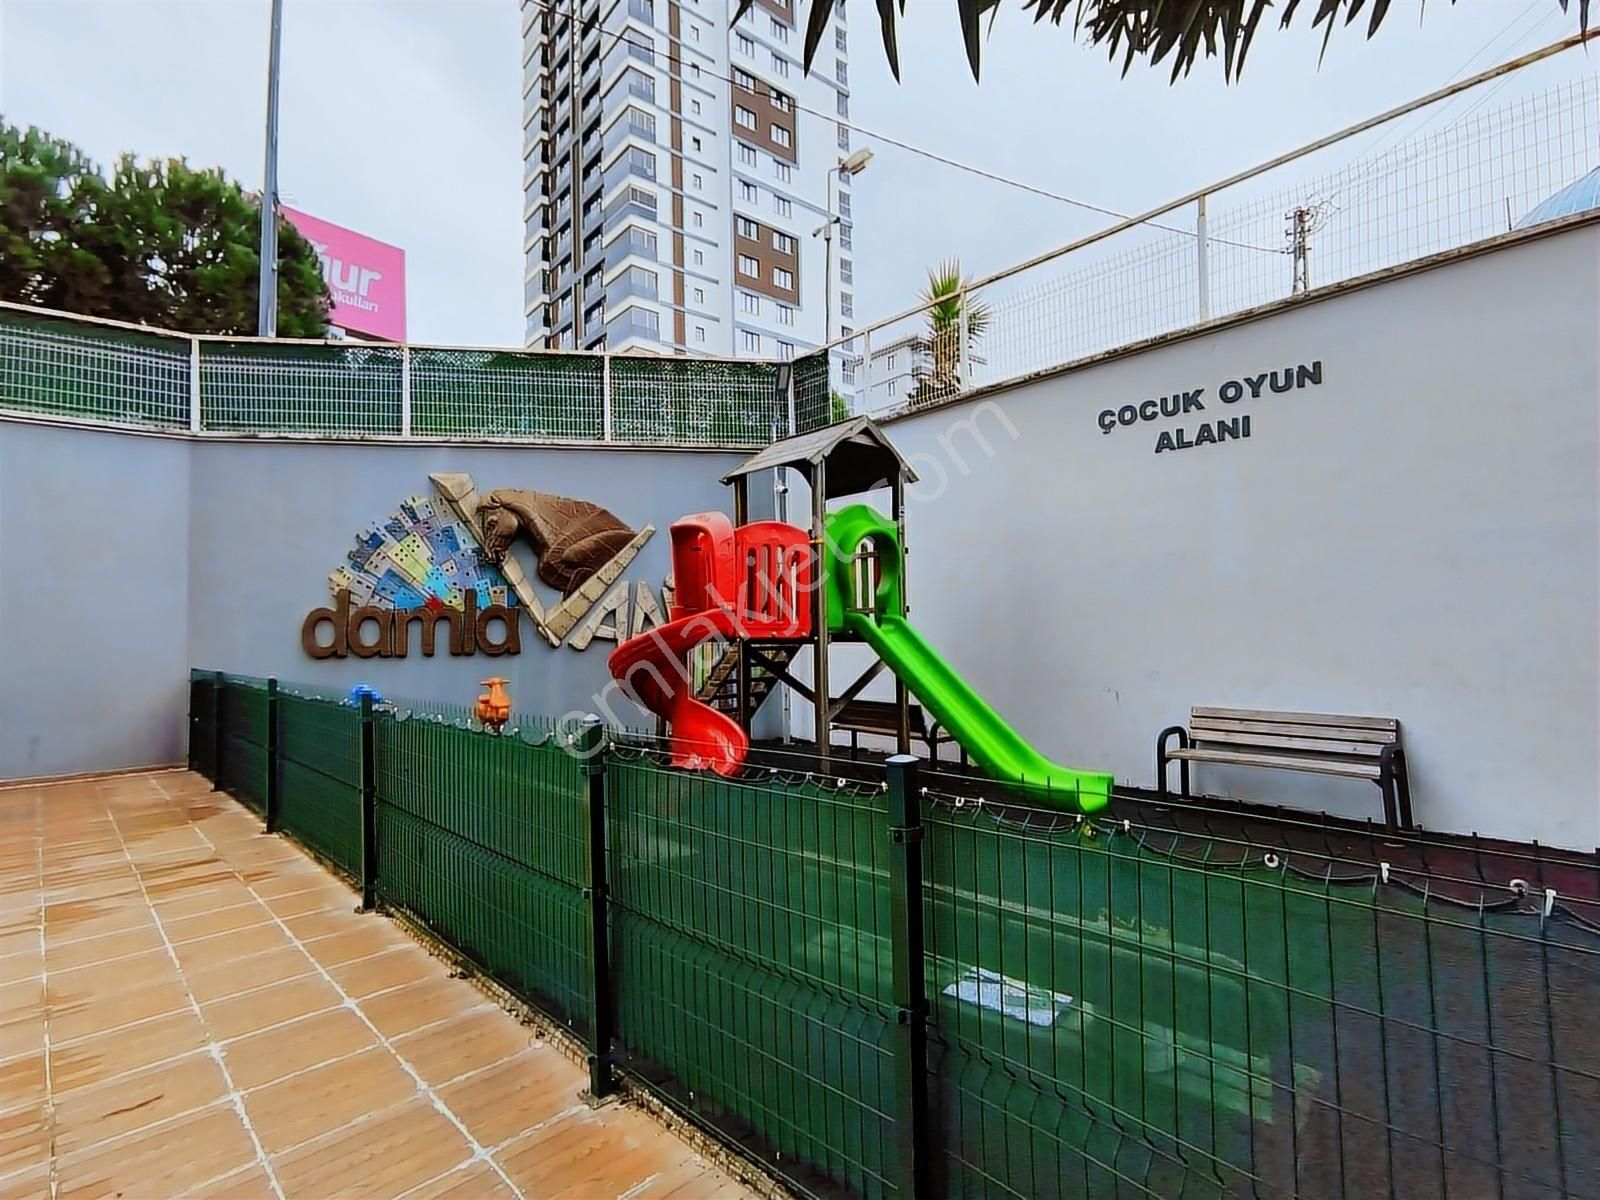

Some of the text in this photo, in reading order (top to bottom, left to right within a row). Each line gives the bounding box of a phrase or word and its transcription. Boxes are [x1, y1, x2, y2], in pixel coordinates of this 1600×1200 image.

[1098, 361, 1323, 435] ÇOCUK OYUN
[1155, 415, 1251, 454] ALANI
[302, 588, 521, 660] damla
